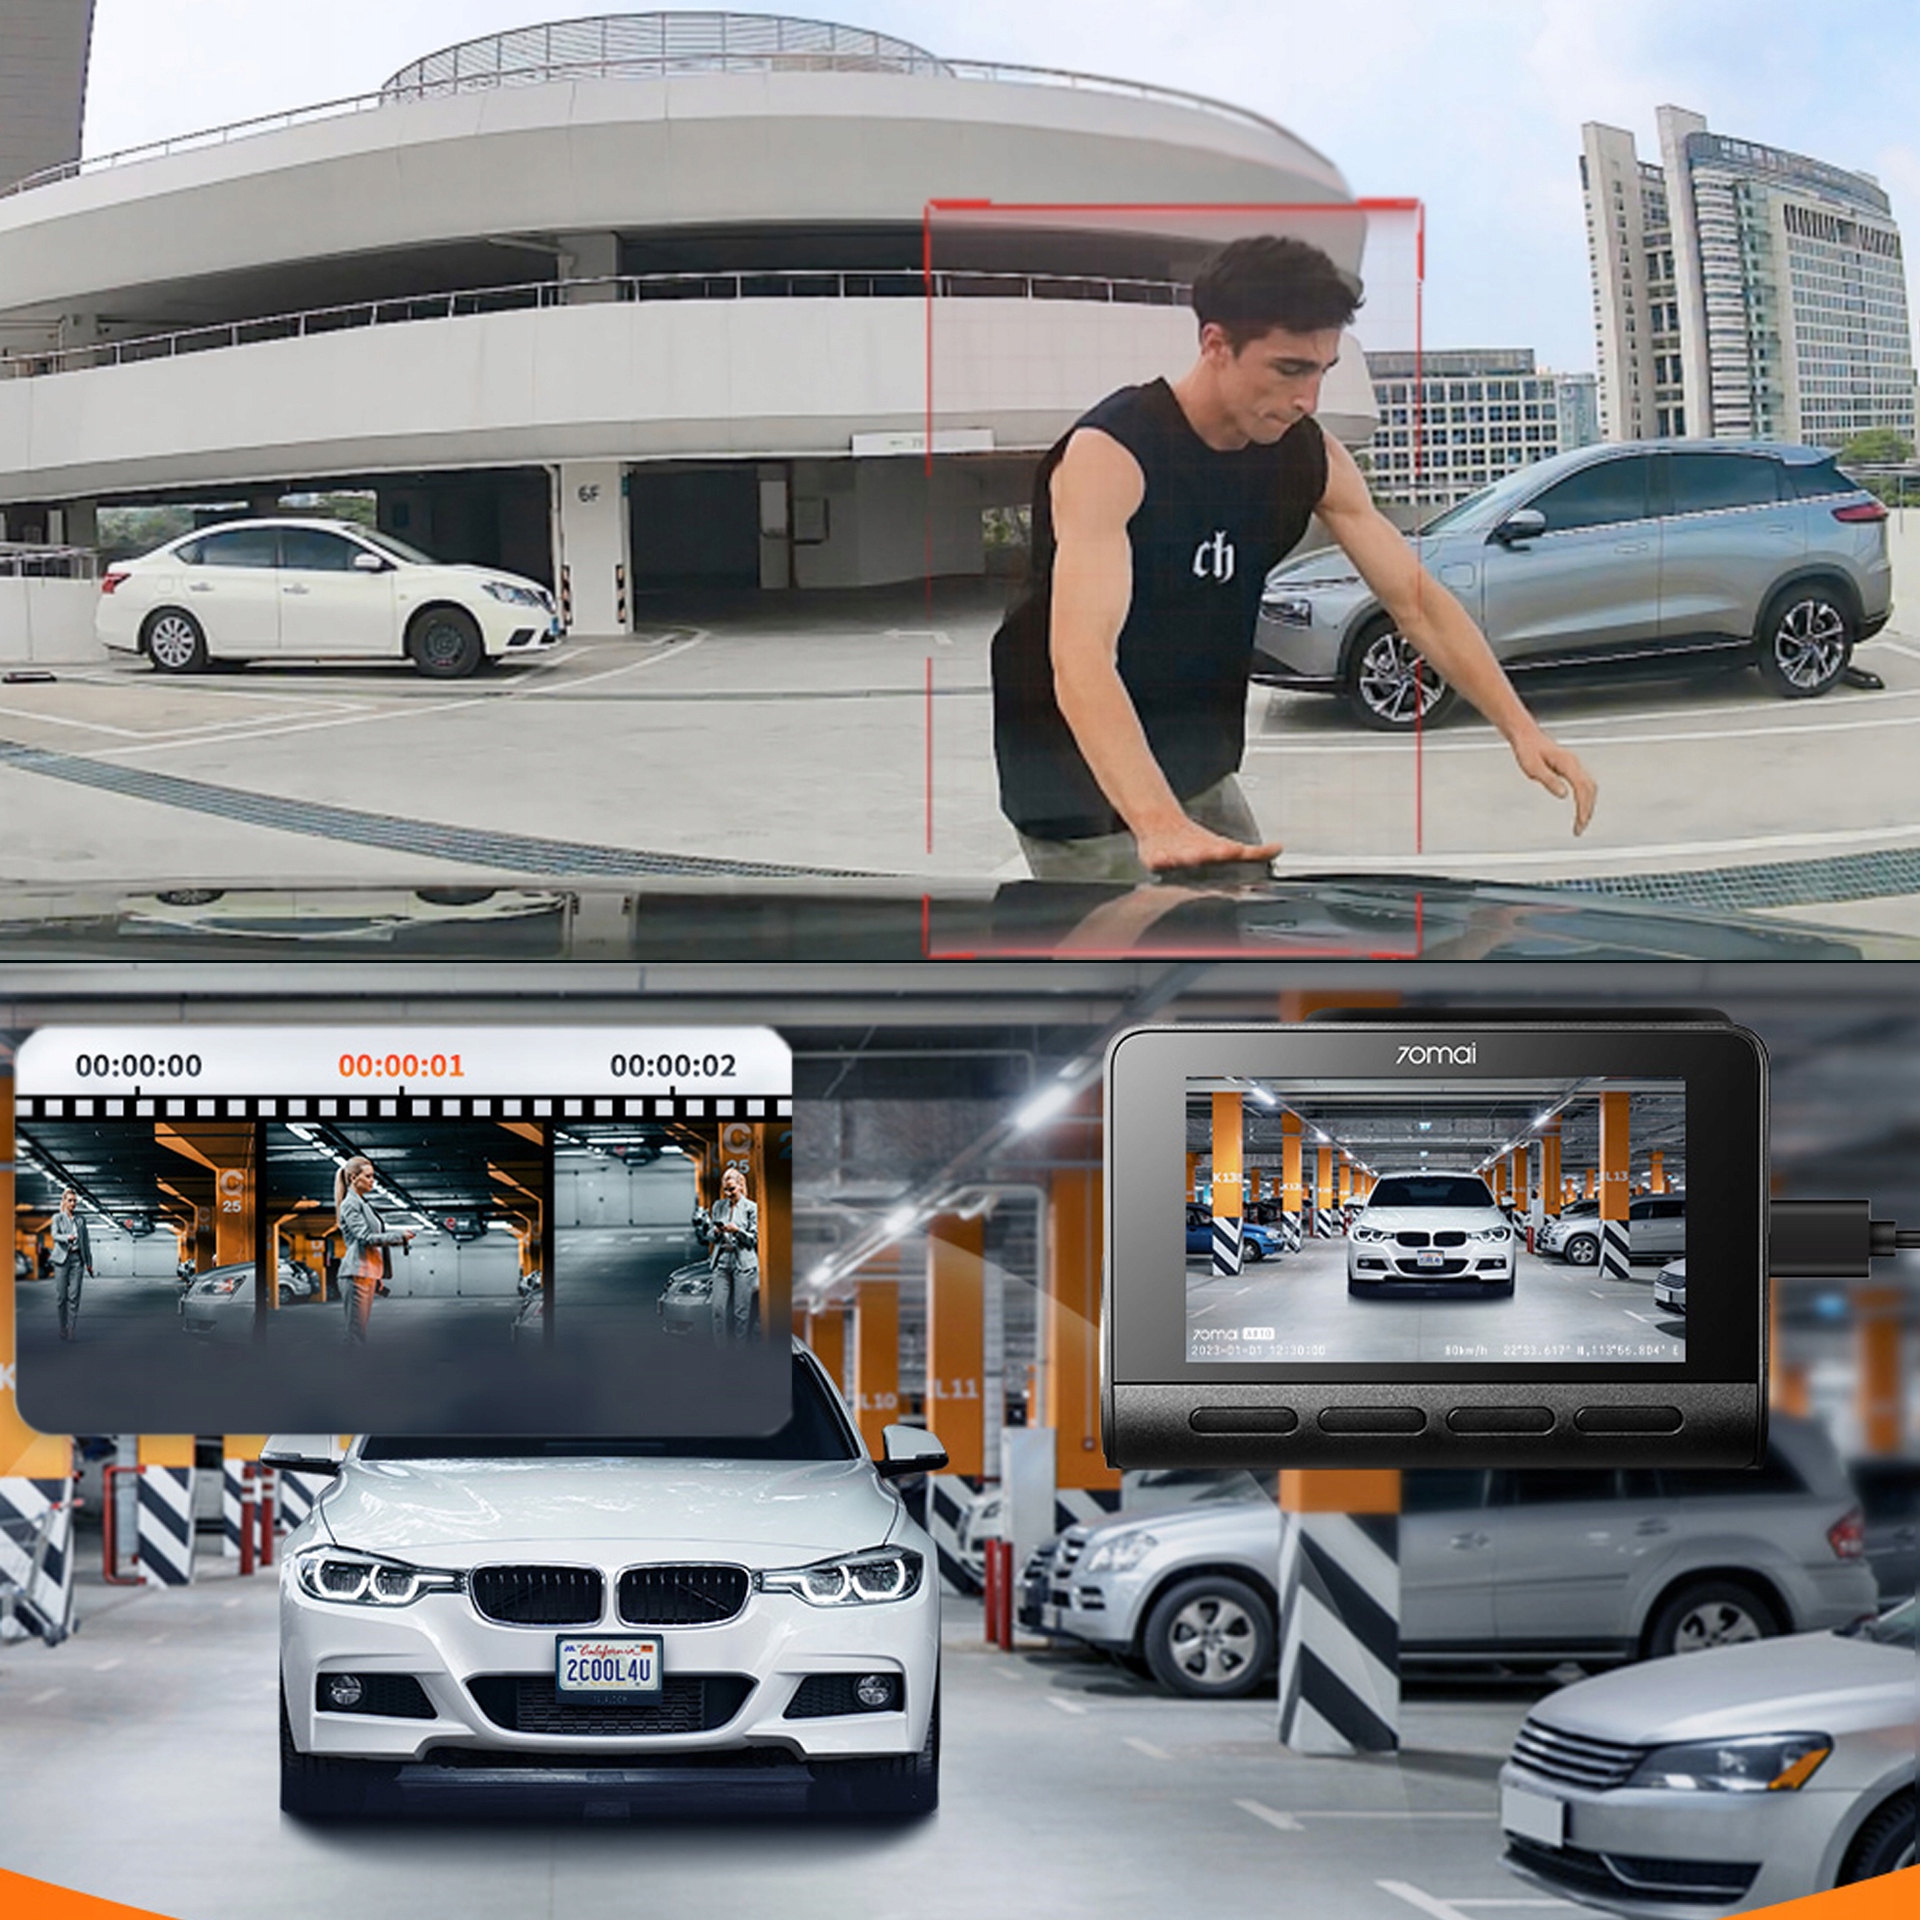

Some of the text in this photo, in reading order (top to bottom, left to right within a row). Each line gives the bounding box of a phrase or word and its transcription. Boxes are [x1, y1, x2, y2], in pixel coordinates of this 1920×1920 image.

[578, 484, 601, 502] 6F
[222, 1199, 242, 1213] 25
[1191, 1344, 1263, 1356] 2023-01-01
[580, 1644, 639, 1660] California
